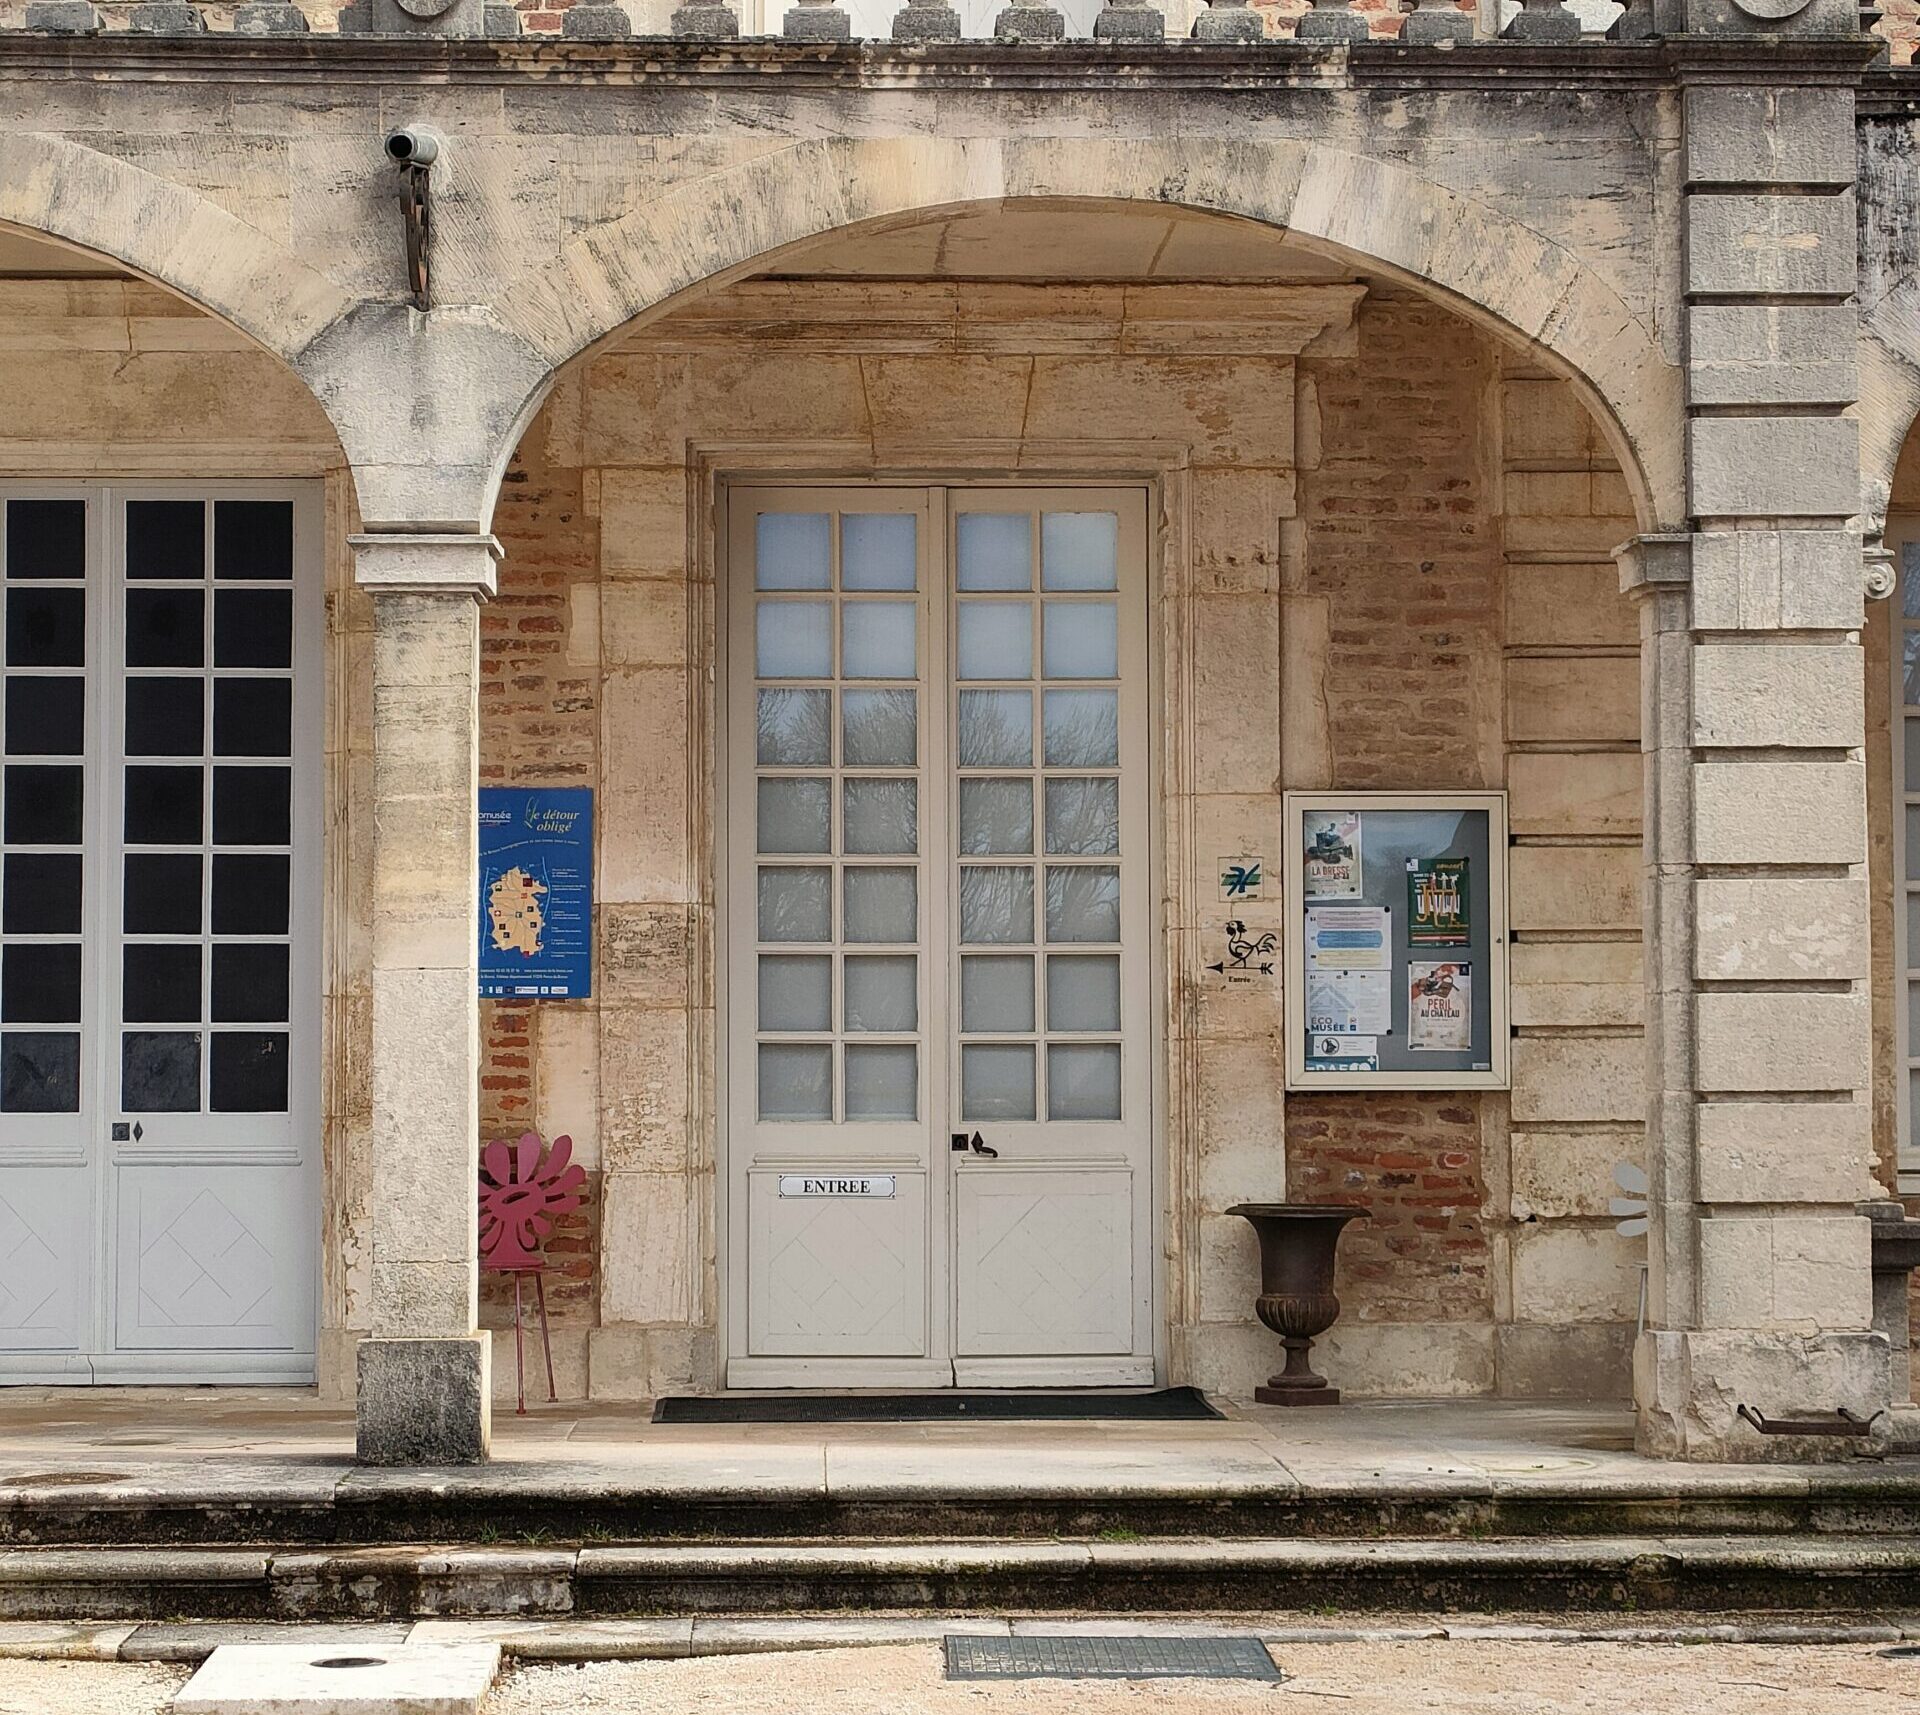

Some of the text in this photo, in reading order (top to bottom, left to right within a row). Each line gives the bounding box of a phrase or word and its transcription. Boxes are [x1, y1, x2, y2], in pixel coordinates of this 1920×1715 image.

[542, 809, 580, 820] détour
[536, 820, 573, 833] obligé
[1311, 866, 1322, 876] LA
[1228, 975, 1251, 984] Entrée
[1420, 1009, 1430, 1018] AU
[1310, 1014, 1333, 1025] ÉCO
[1310, 1023, 1346, 1032] MUSÉE
[803, 1179, 871, 1194] ENTREE
